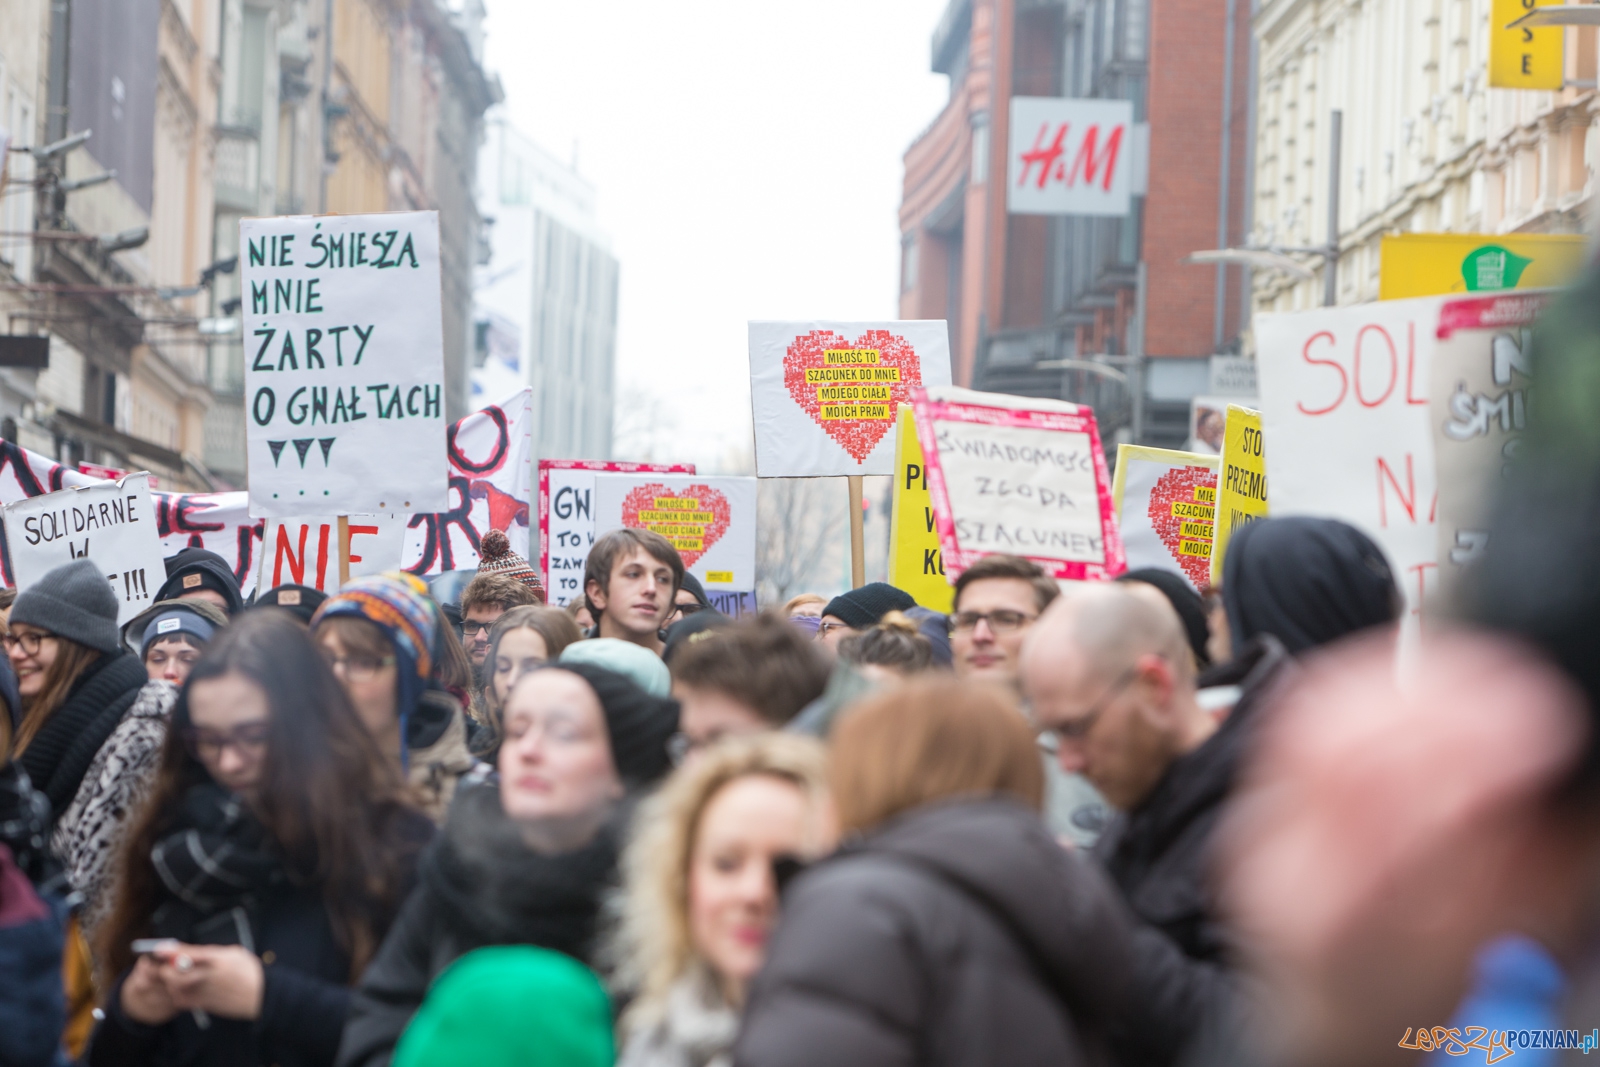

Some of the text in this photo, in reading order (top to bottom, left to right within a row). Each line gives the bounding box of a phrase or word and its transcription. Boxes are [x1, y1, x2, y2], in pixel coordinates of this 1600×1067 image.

[1018, 121, 1125, 192] H&M
[249, 222, 419, 269] NIE ŚMIESZĄ
[251, 278, 323, 315] MNIE
[252, 322, 375, 372] ŻARTY
[827, 351, 877, 364] MIŁOŚĆ TO
[808, 368, 898, 382] SZACUNEK DO MNIE
[821, 386, 887, 400] MOJEGO CIAŁA
[252, 384, 441, 426] O GWAŁTACH
[825, 406, 885, 418] MOICH PRAW
[1243, 426, 1265, 458] STO
[656, 499, 696, 508] MIŁOŚĆ TO
[24, 494, 140, 546] SOLIDARNE
[640, 511, 711, 521] SZACUNEK DO MNIE
[650, 525, 702, 535] MOJEGO CIAŁA
[956, 518, 1104, 552] SZACUNEK
[557, 530, 581, 547] TO
[677, 540, 699, 548] PRAW
[560, 578, 578, 590] TO
